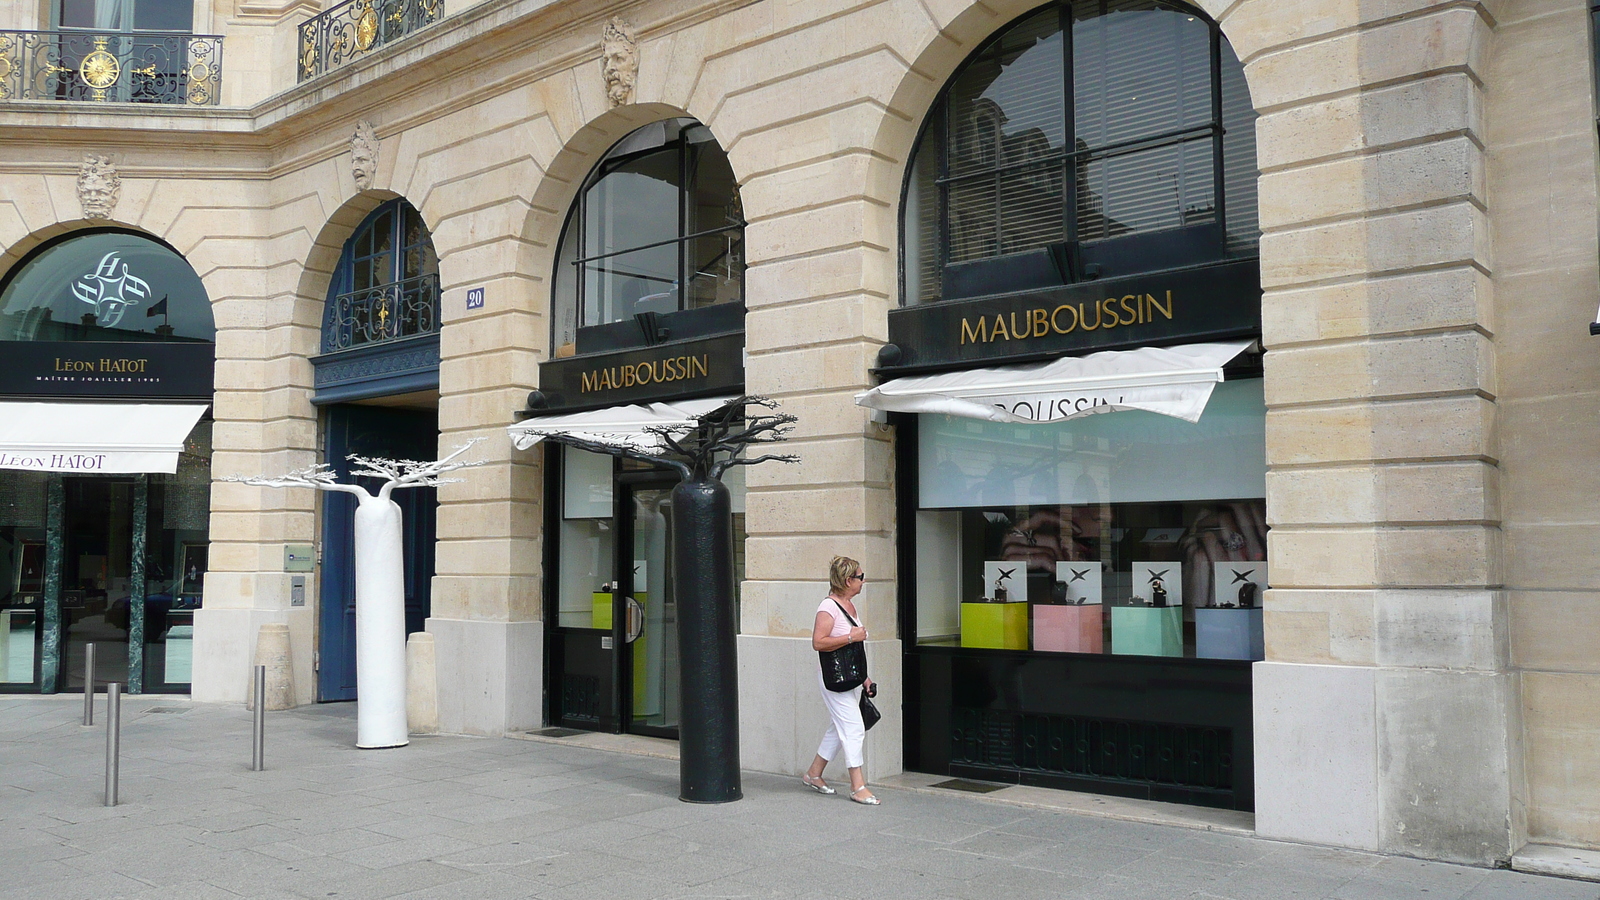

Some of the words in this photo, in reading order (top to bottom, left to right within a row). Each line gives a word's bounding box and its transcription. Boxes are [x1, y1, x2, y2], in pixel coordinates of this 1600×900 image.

[468, 290, 482, 307] 20
[960, 289, 1174, 345] MAUBOUSSIN
[55, 357, 95, 372] LÉON
[99, 358, 148, 373] HATOT
[581, 353, 709, 393] MAUBOUSSIN
[0, 453, 46, 467] LÉON
[50, 454, 107, 469] HATOT
